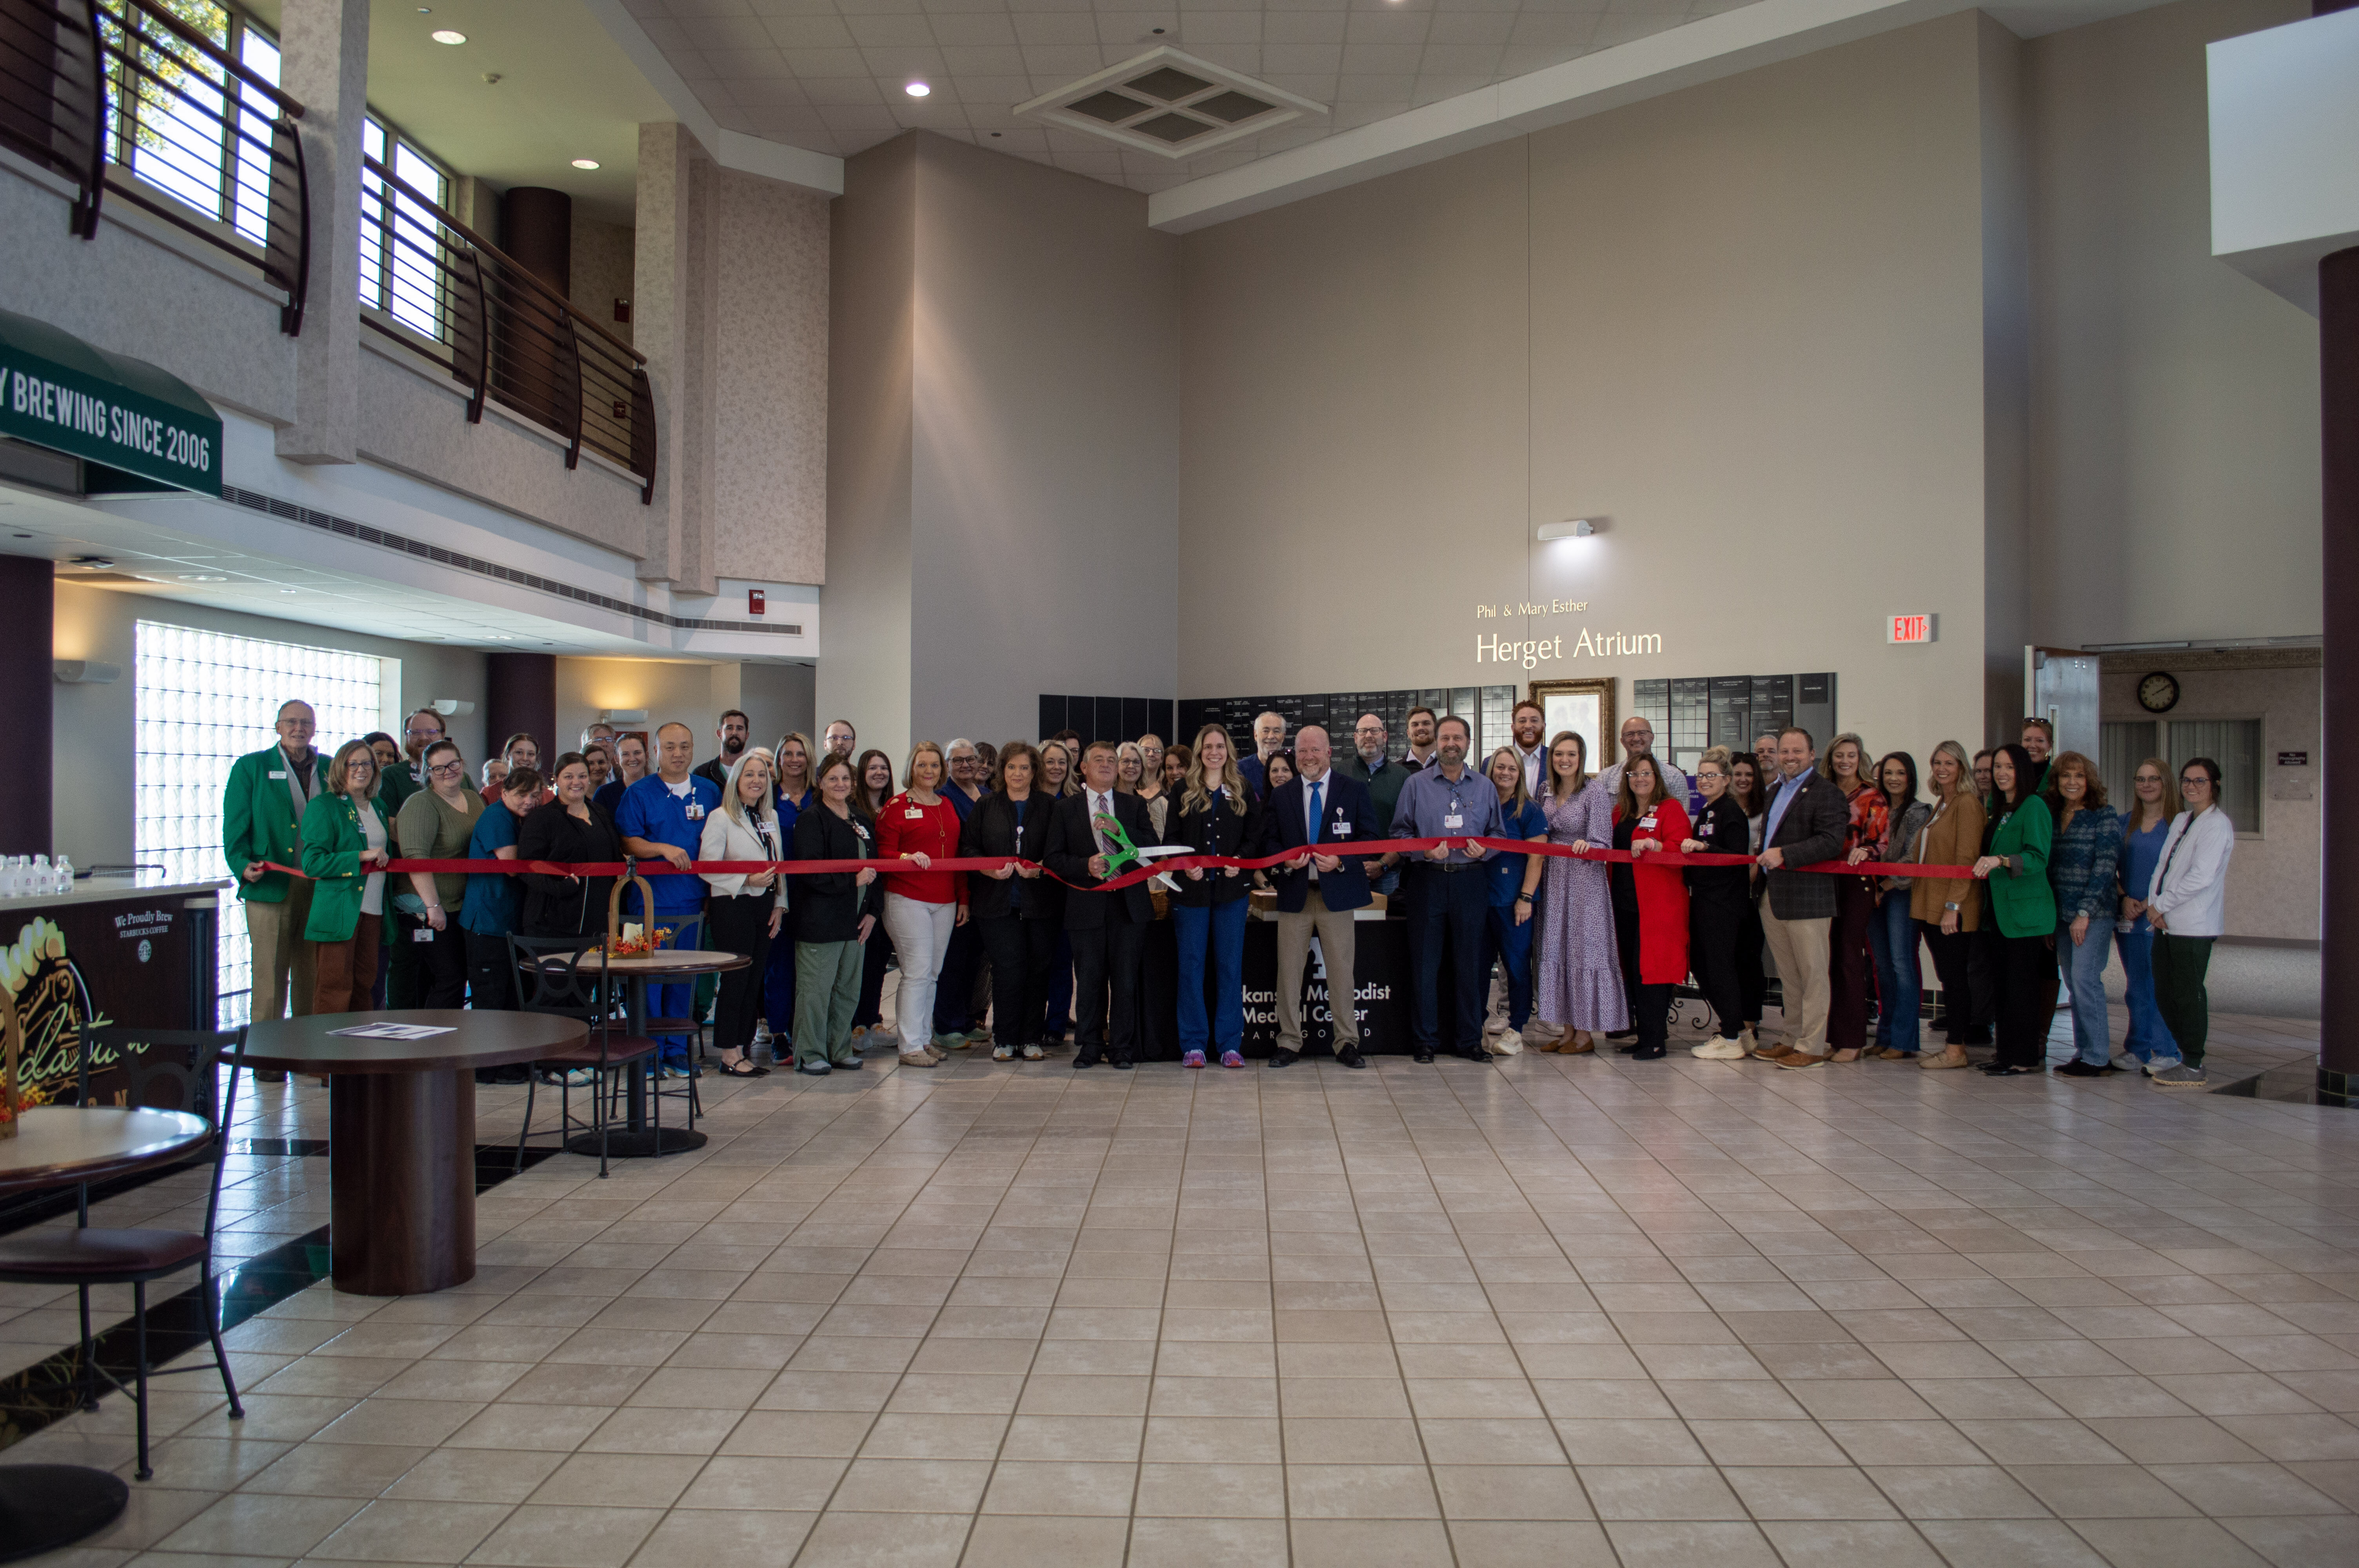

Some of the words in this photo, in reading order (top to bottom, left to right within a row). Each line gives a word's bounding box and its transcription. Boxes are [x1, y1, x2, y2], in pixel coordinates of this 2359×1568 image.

[13, 371, 107, 439] BREWING
[111, 405, 163, 457] SINCE
[167, 426, 210, 472] 2006
[1477, 604, 1496, 619] Phil
[1503, 605, 1512, 617] &
[1518, 602, 1548, 618] Mary
[1553, 599, 1588, 613] Esther
[1894, 616, 1924, 641] EXIT
[1477, 633, 1562, 670] Herget
[1573, 627, 1662, 658] Atrium
[115, 915, 127, 928] We
[128, 911, 155, 924] Proudly
[156, 910, 173, 922] Brew
[120, 927, 149, 938] STARBUCKS
[149, 925, 169, 935] COFFEE
[1307, 982, 1391, 1001] Meodist
[1312, 1005, 1368, 1022] Ceer
